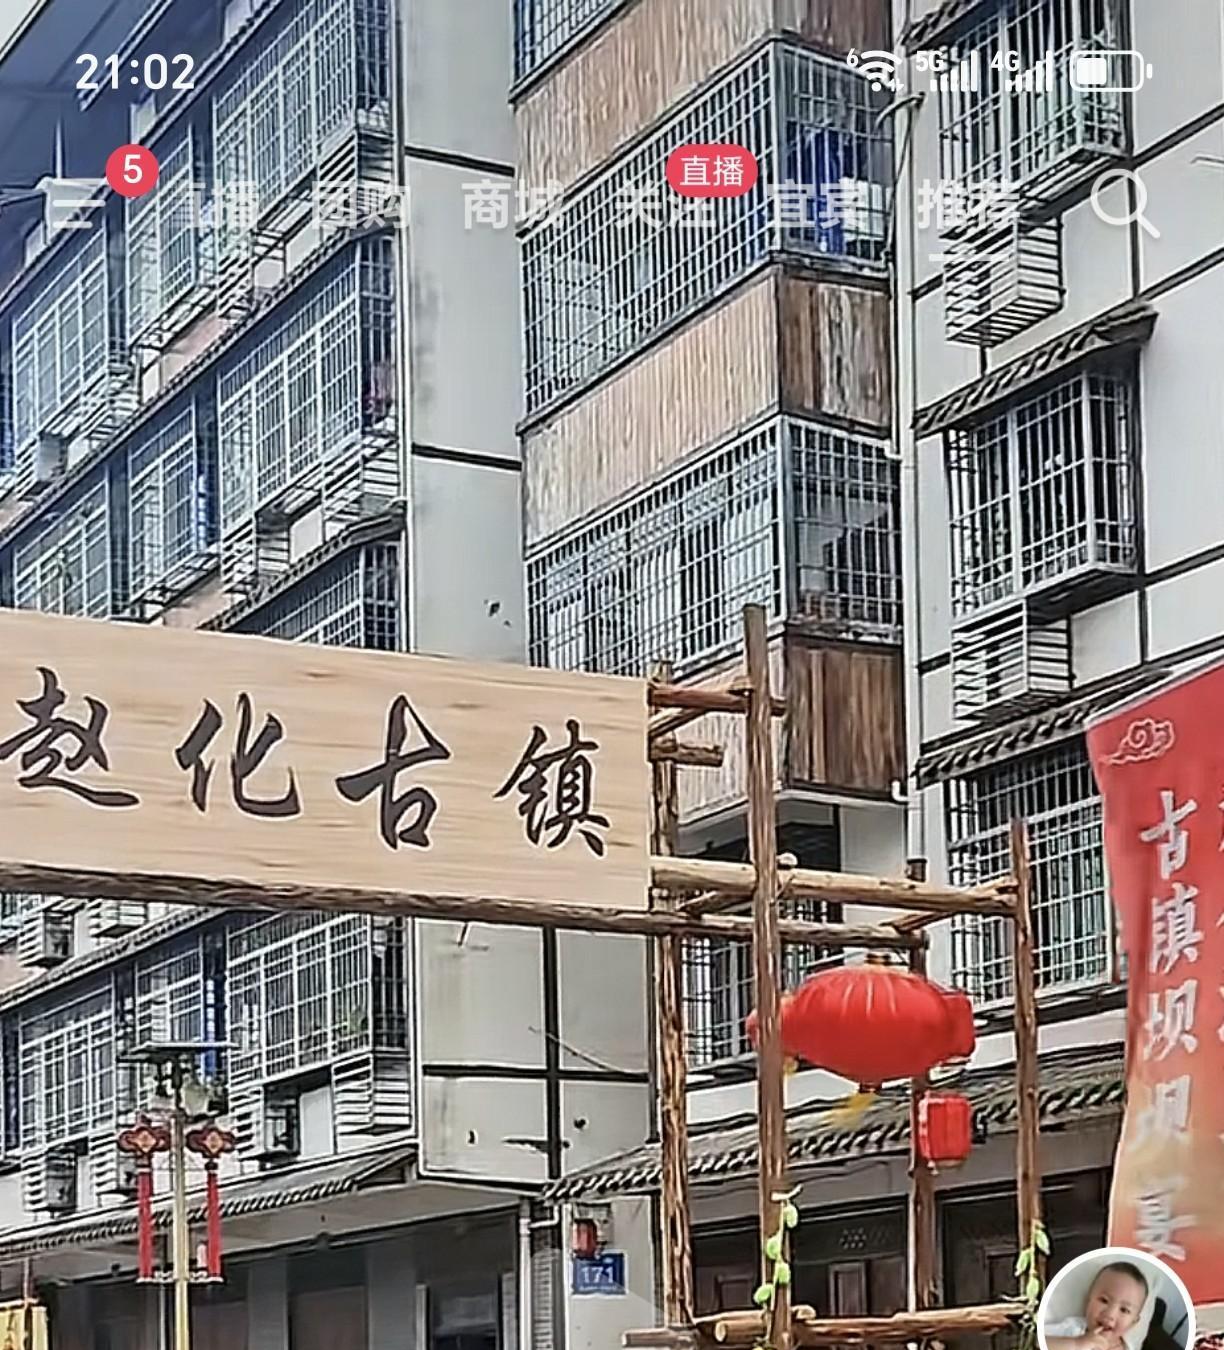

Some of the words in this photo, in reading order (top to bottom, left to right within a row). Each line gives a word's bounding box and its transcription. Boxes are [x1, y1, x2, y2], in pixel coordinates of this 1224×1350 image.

[0, 666, 611, 857] 赵化古镇
[581, 1266, 614, 1284] 171
